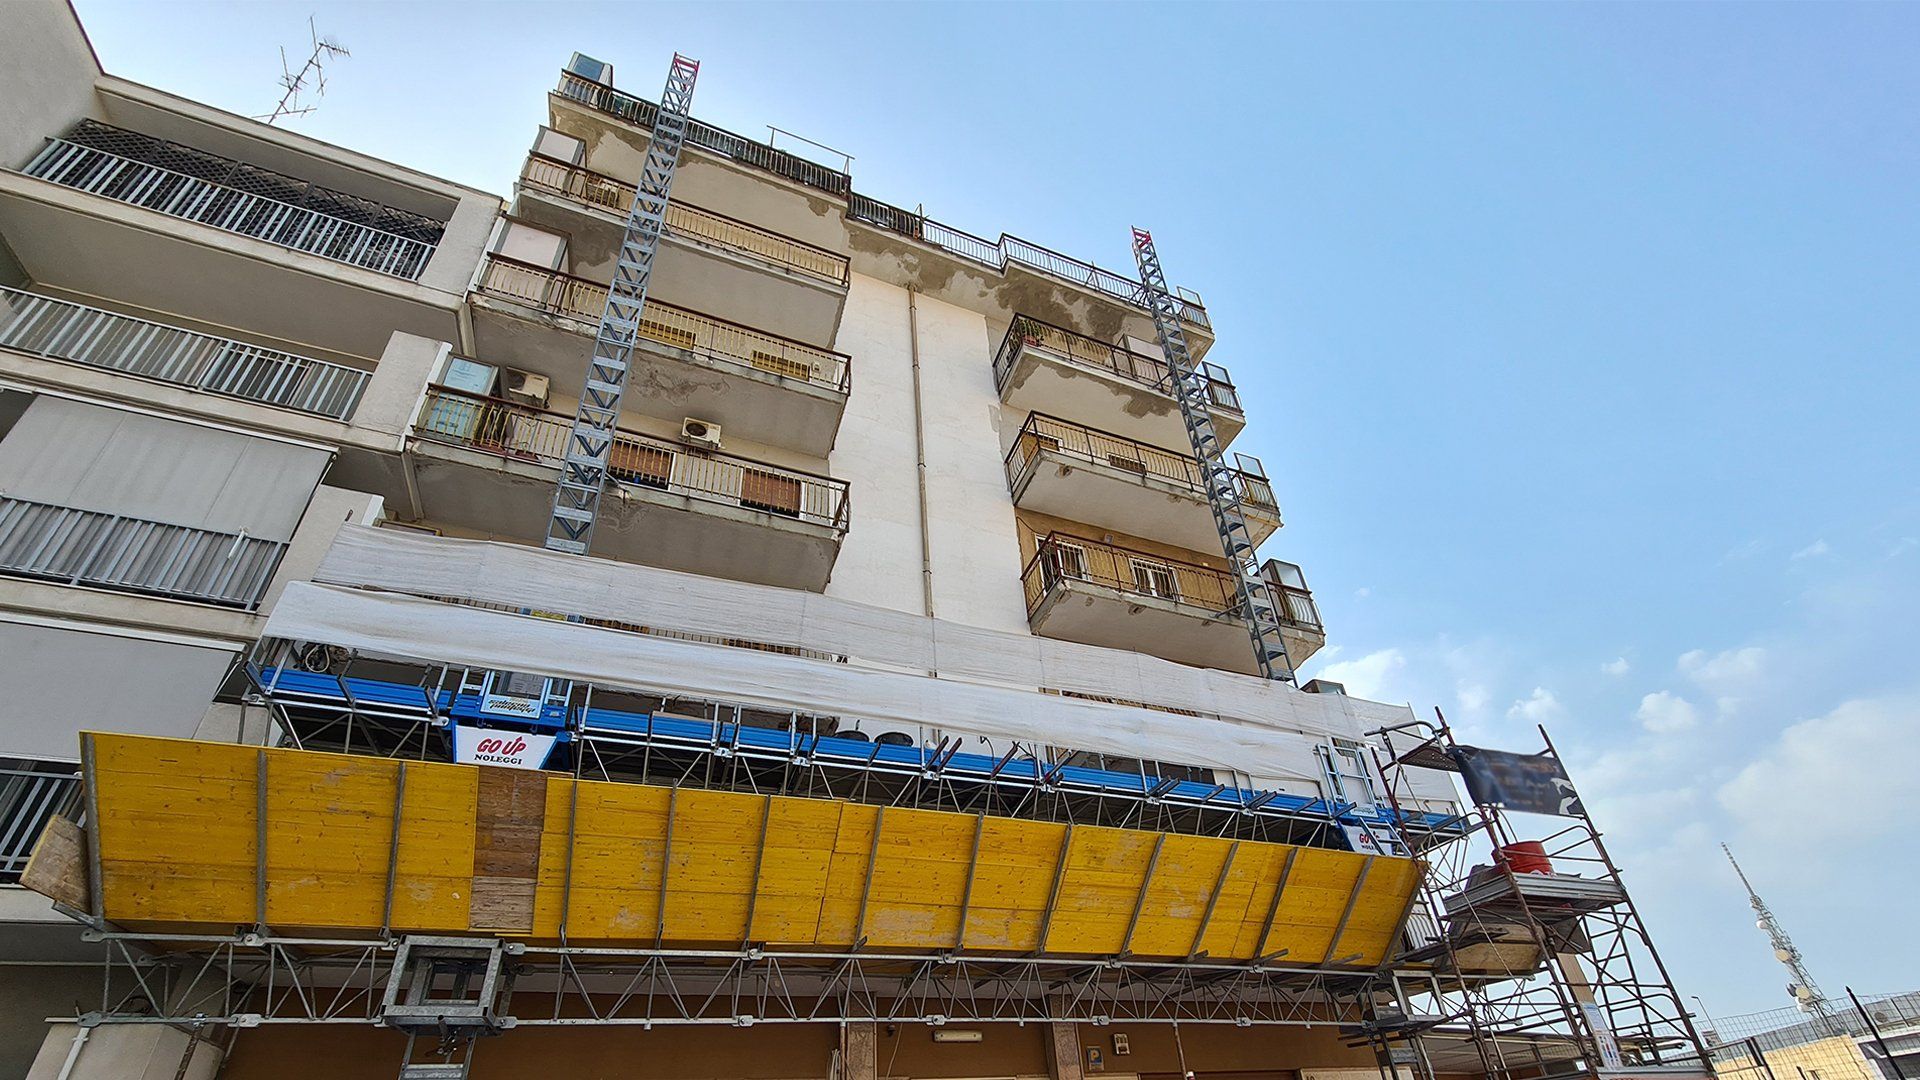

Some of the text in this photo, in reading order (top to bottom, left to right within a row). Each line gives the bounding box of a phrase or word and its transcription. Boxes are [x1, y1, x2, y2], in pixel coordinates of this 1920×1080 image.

[477, 736, 527, 756] GO UP
[474, 754, 522, 765] NOLEGGI
